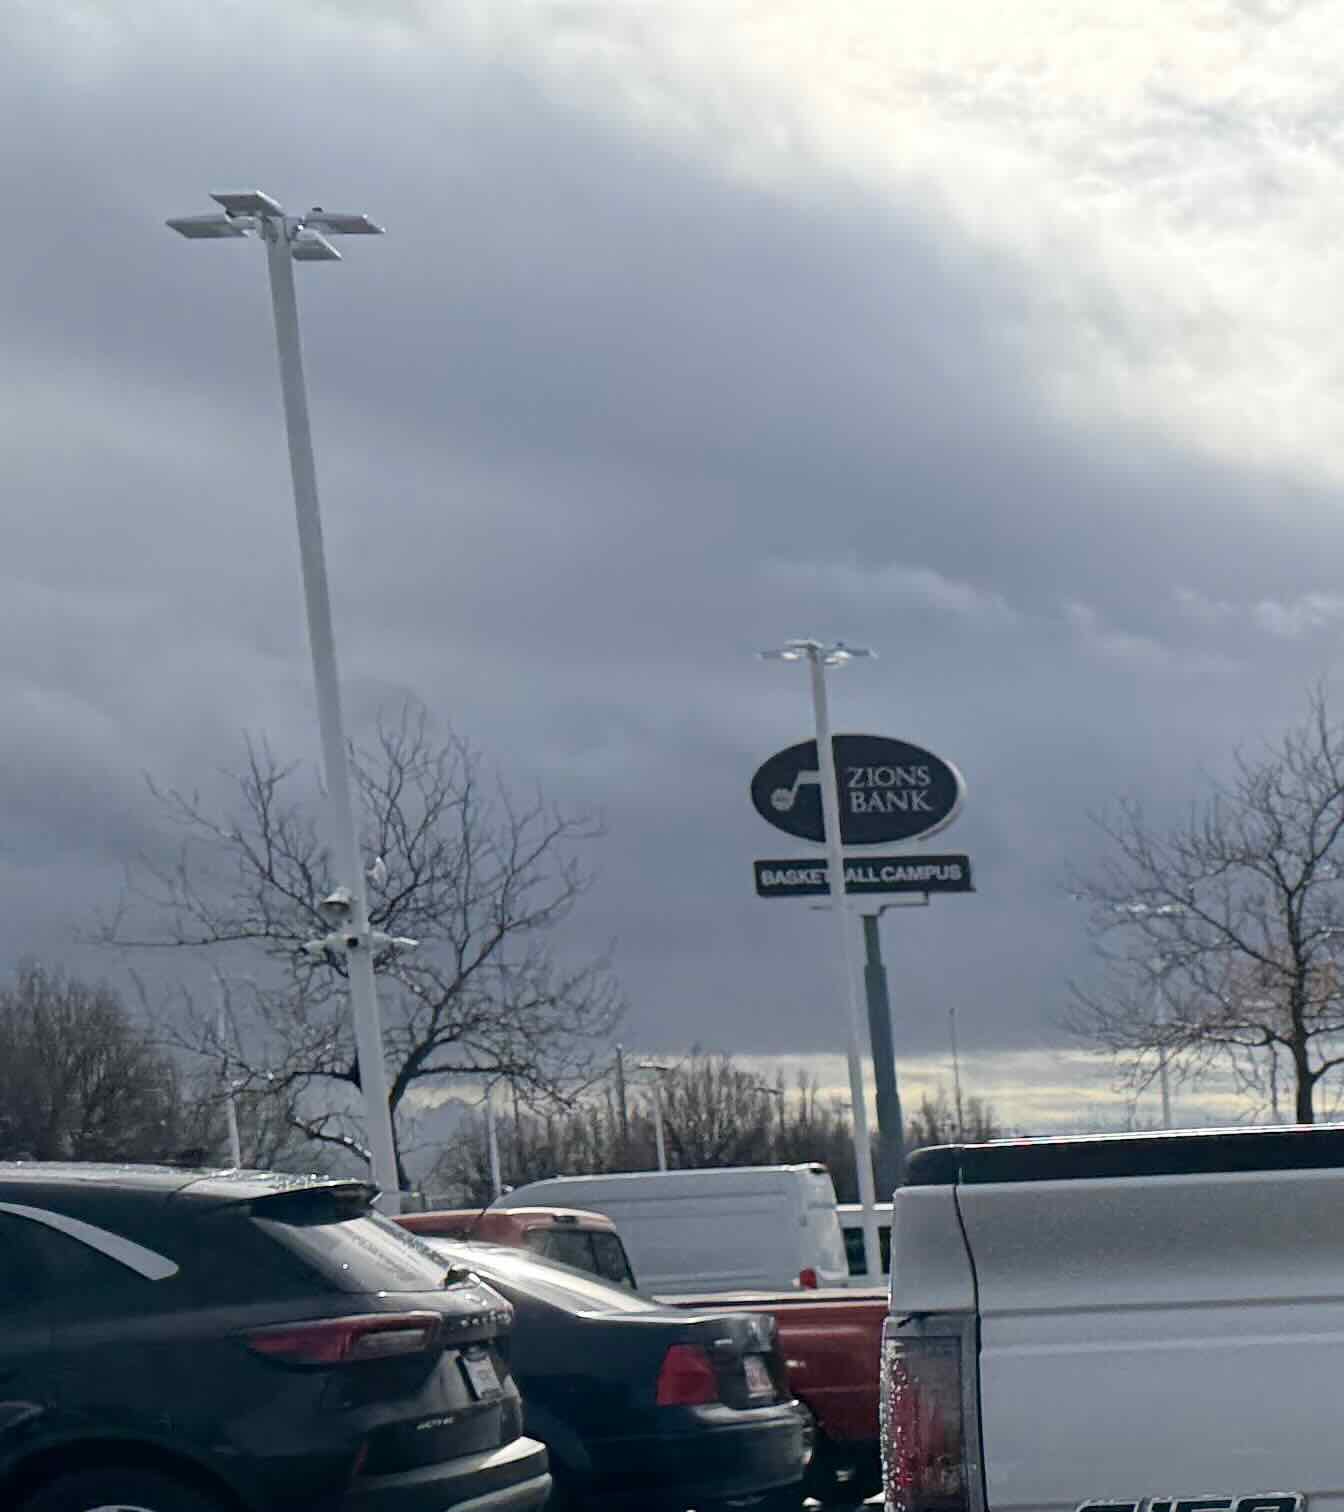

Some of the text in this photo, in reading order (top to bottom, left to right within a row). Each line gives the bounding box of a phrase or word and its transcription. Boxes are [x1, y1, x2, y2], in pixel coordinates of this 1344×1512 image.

[848, 766, 931, 789] ZIONS
[850, 789, 934, 814] BANK
[761, 863, 962, 887] BASKETALL CAMPUS
